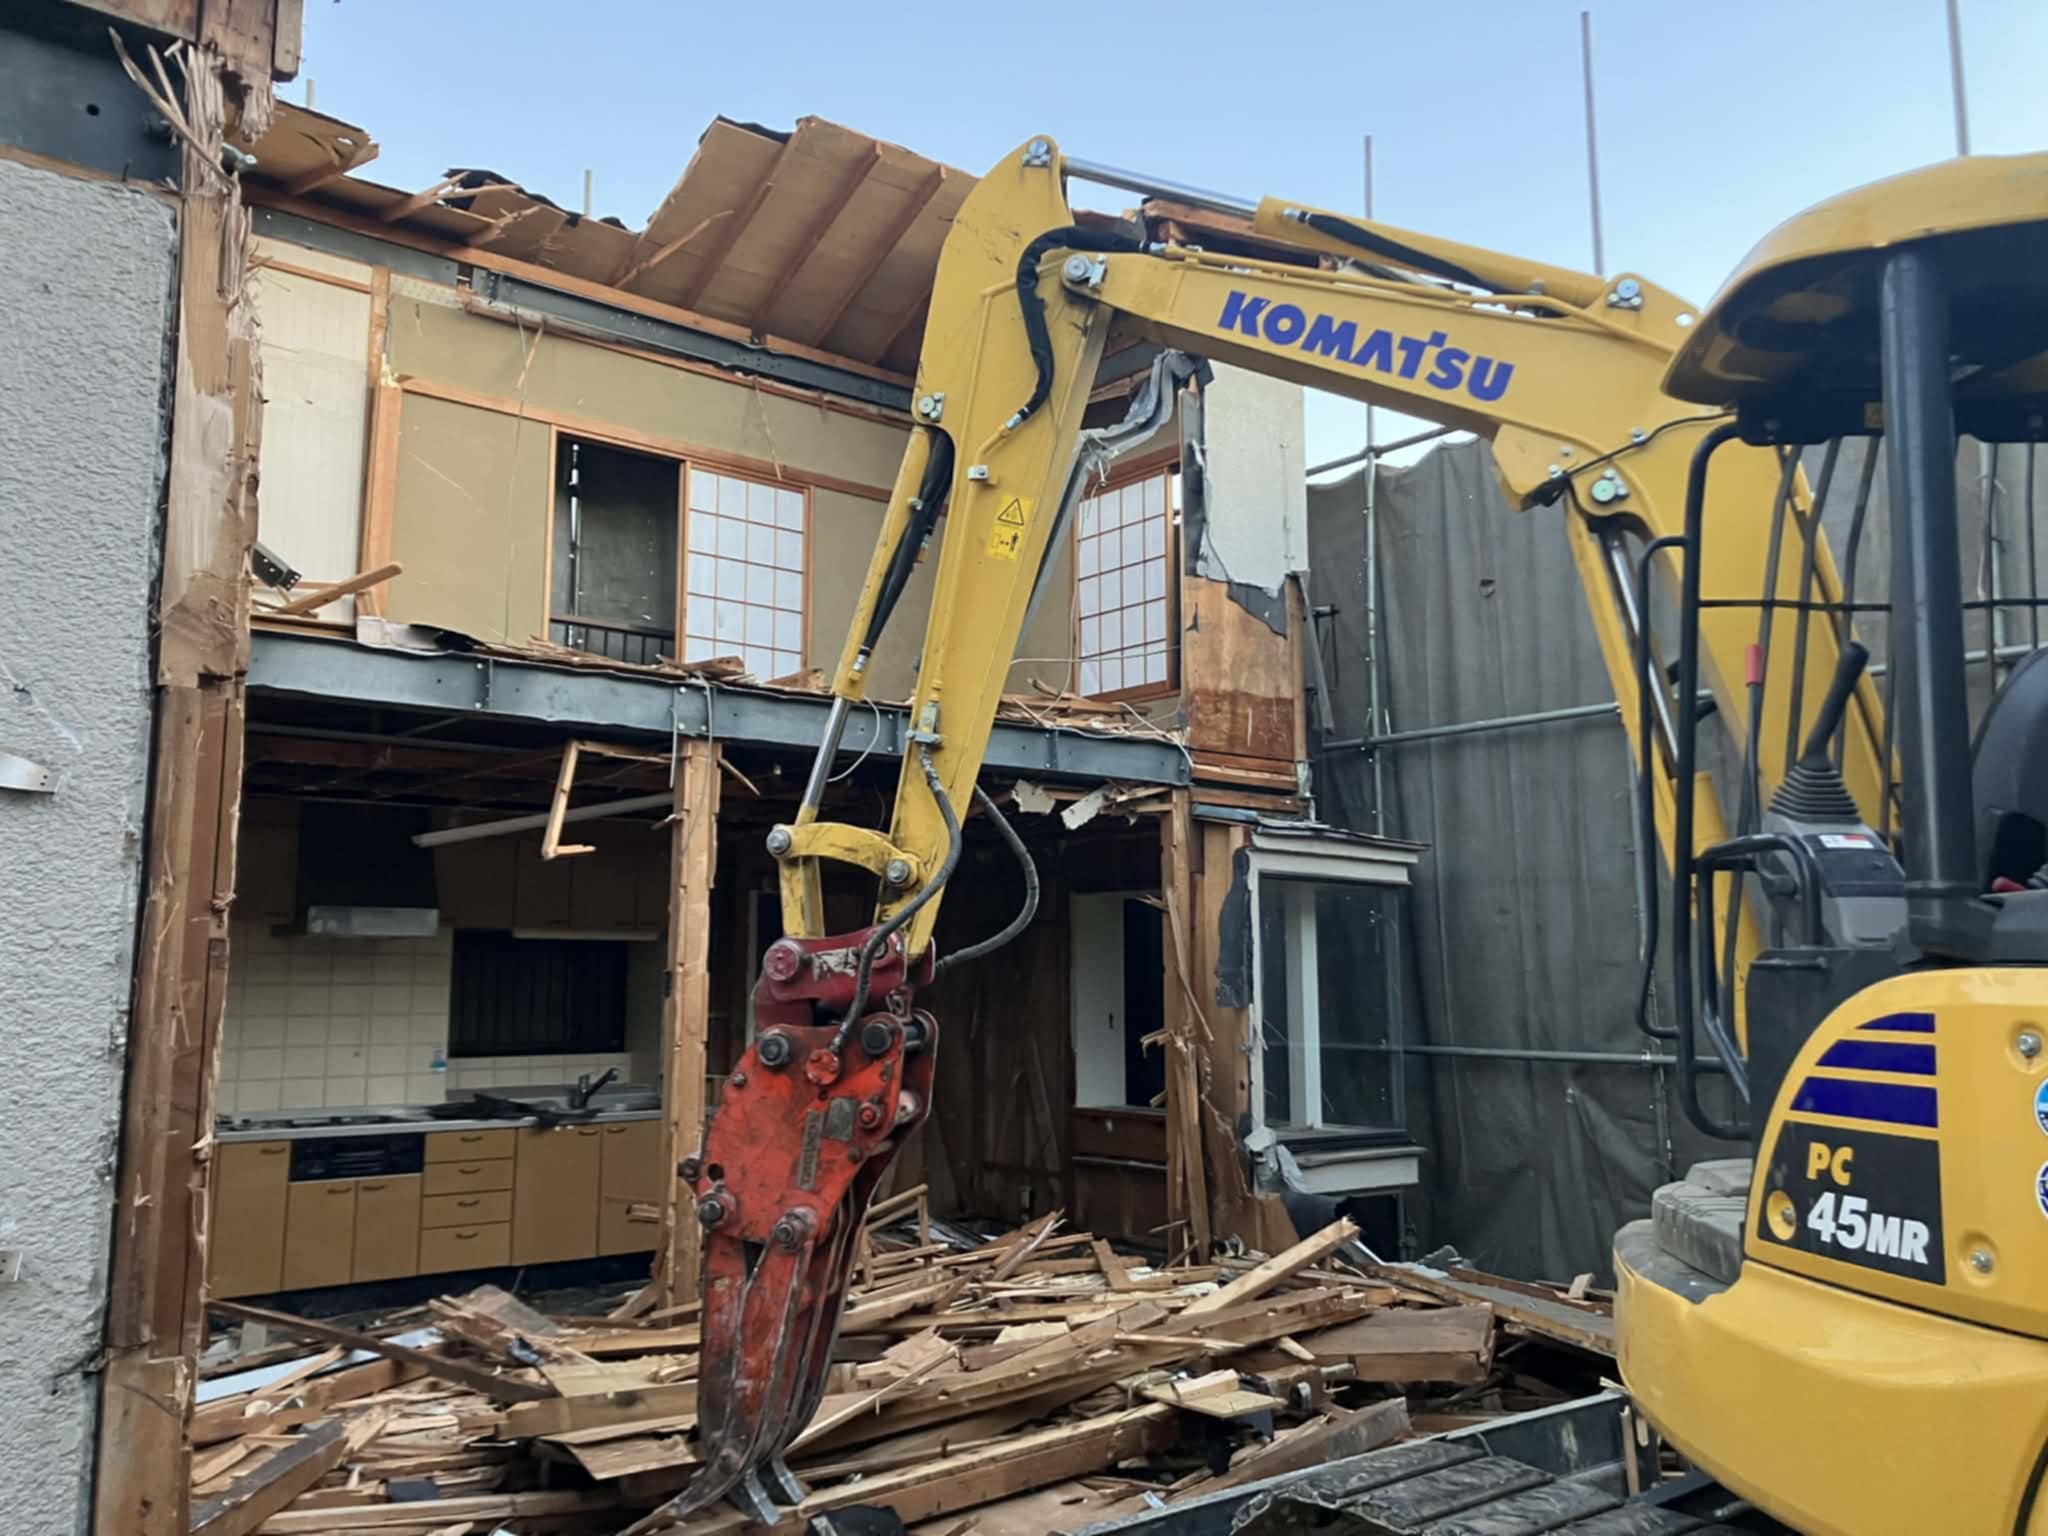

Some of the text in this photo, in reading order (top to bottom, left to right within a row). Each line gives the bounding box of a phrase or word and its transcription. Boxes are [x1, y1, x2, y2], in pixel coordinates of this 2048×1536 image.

[1218, 290, 1515, 402] KOMATSU
[1806, 1142, 1853, 1186] PC
[1807, 1191, 1929, 1264] 45MR
